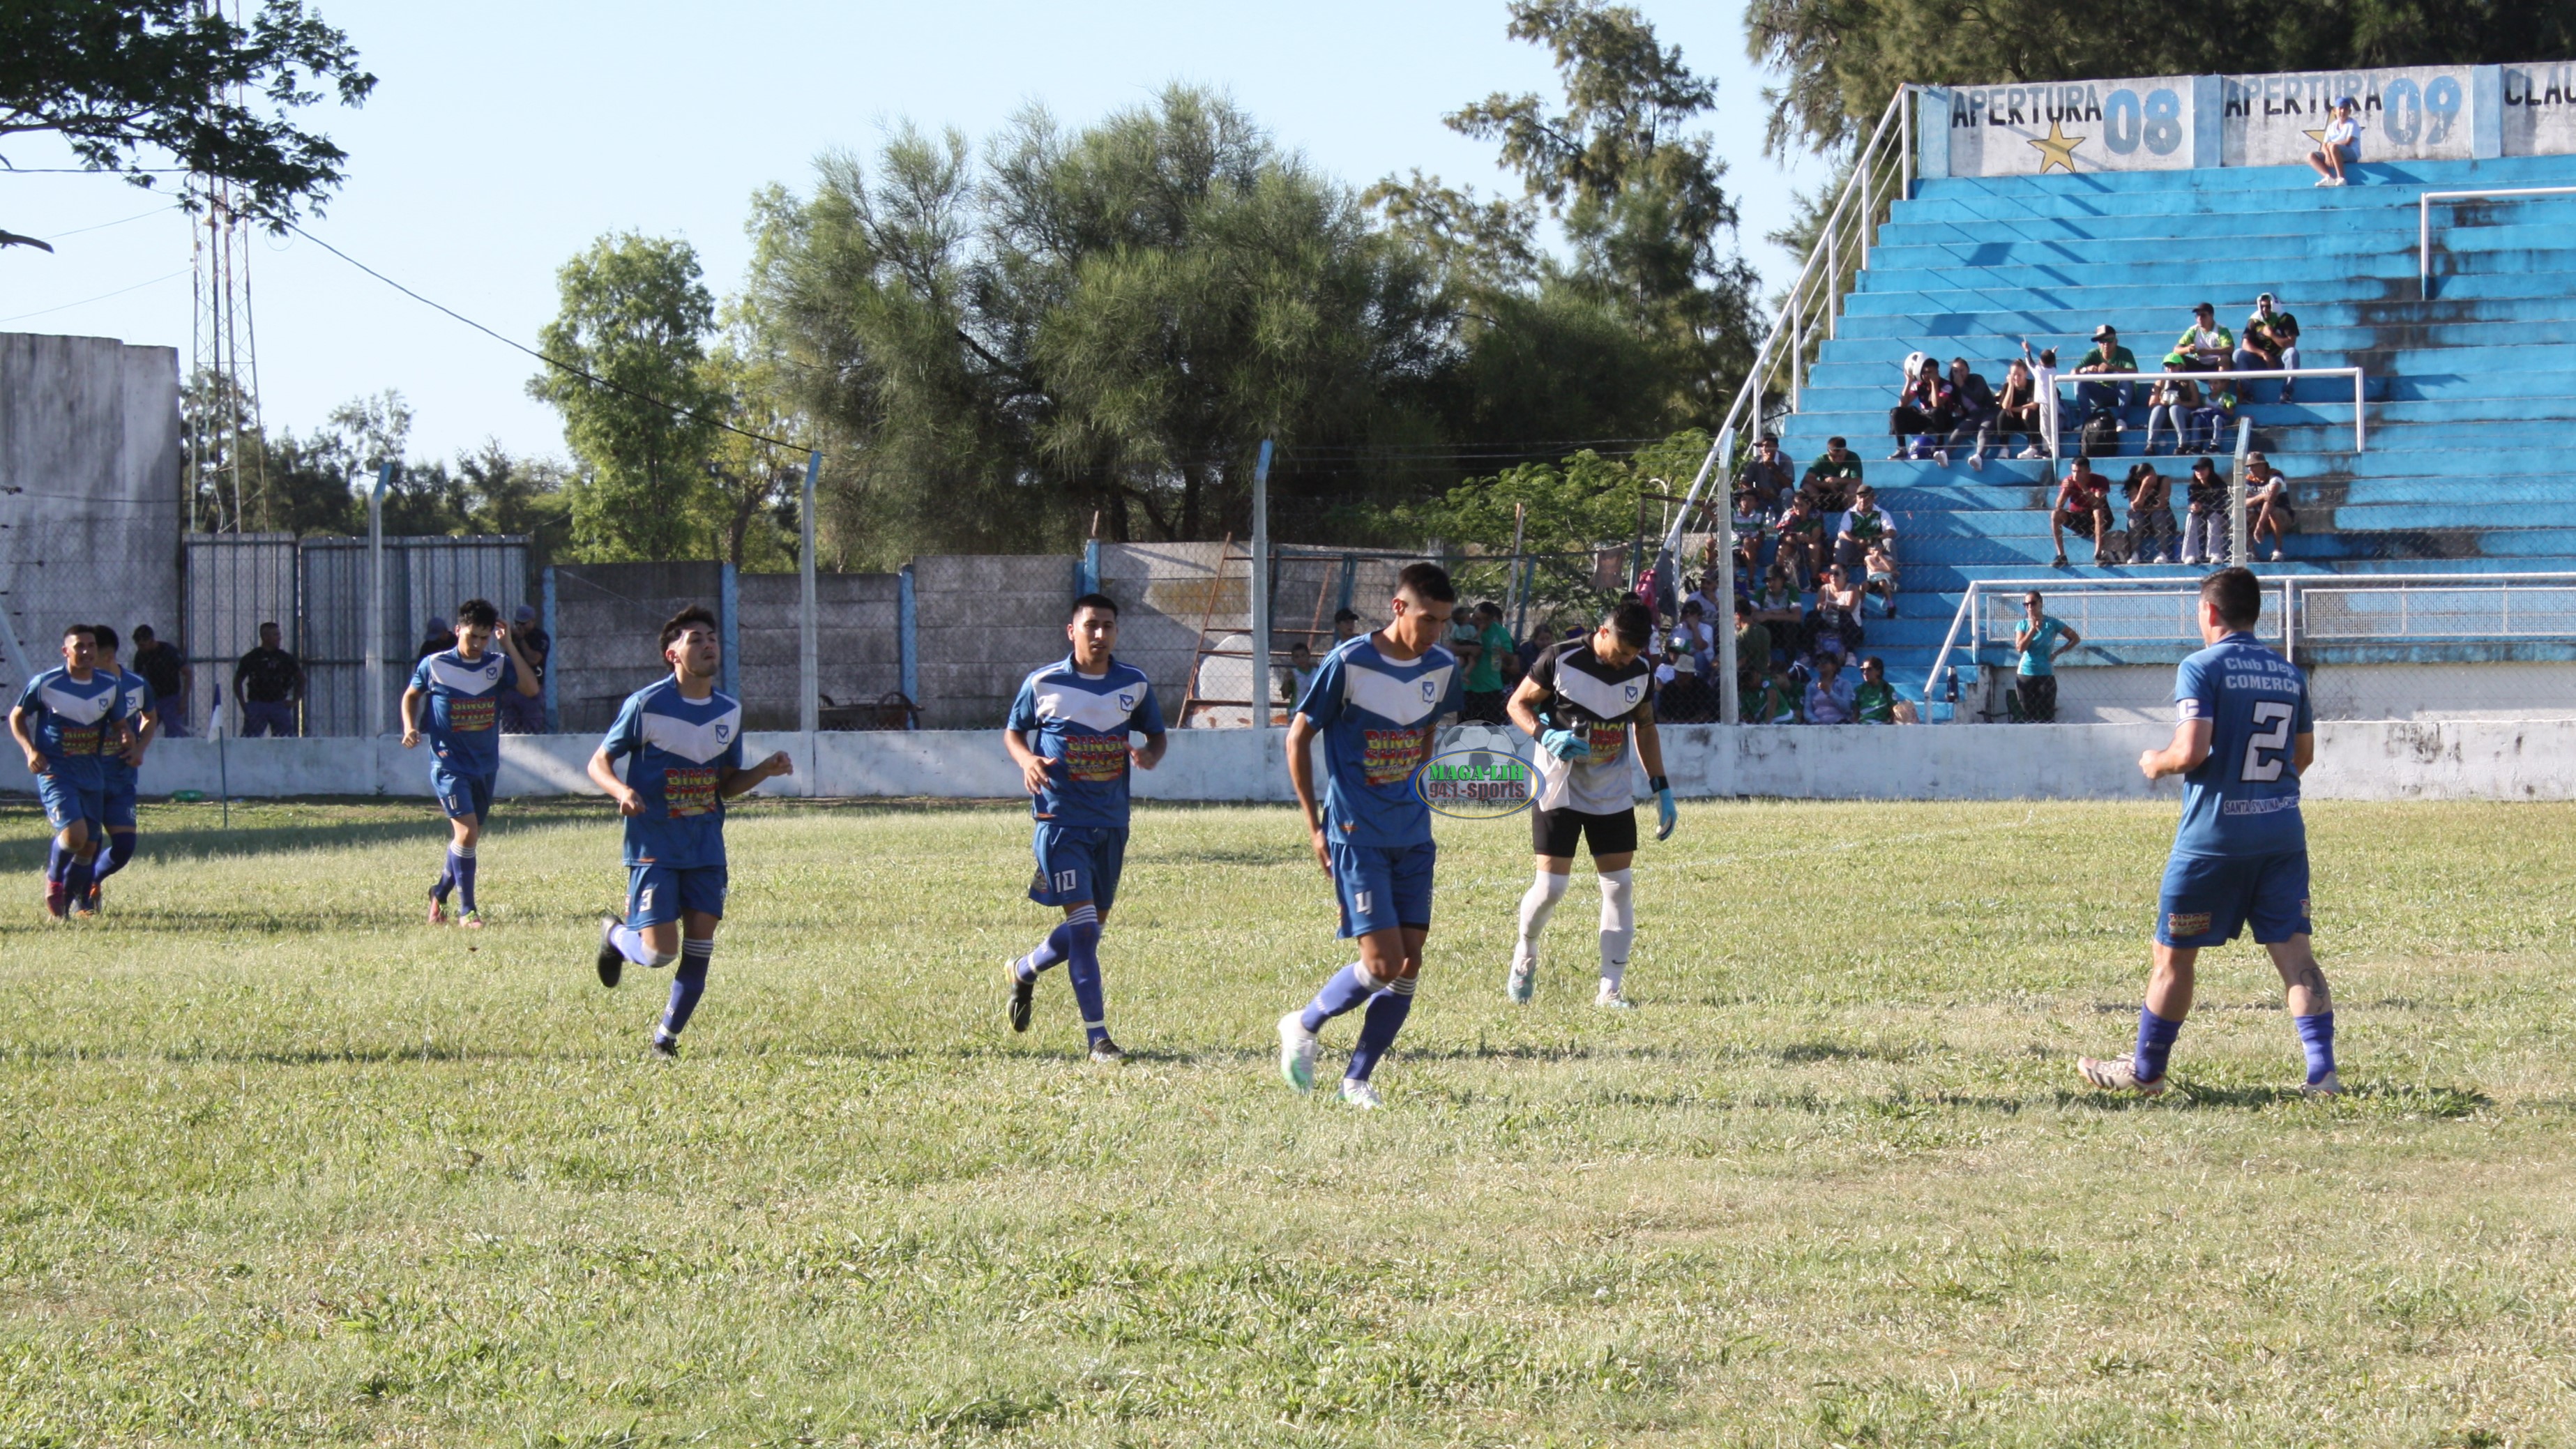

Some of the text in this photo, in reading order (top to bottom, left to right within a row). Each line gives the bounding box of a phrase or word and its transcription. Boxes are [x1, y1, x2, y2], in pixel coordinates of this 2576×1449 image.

[1952, 84, 2182, 156] APERTURA 08
[2225, 73, 2461, 145] APERTURA 09
[2225, 658, 2294, 677] Club Dep
[2241, 700, 2294, 782] 2
[639, 888, 653, 912] 3
[1054, 869, 1077, 893] 10
